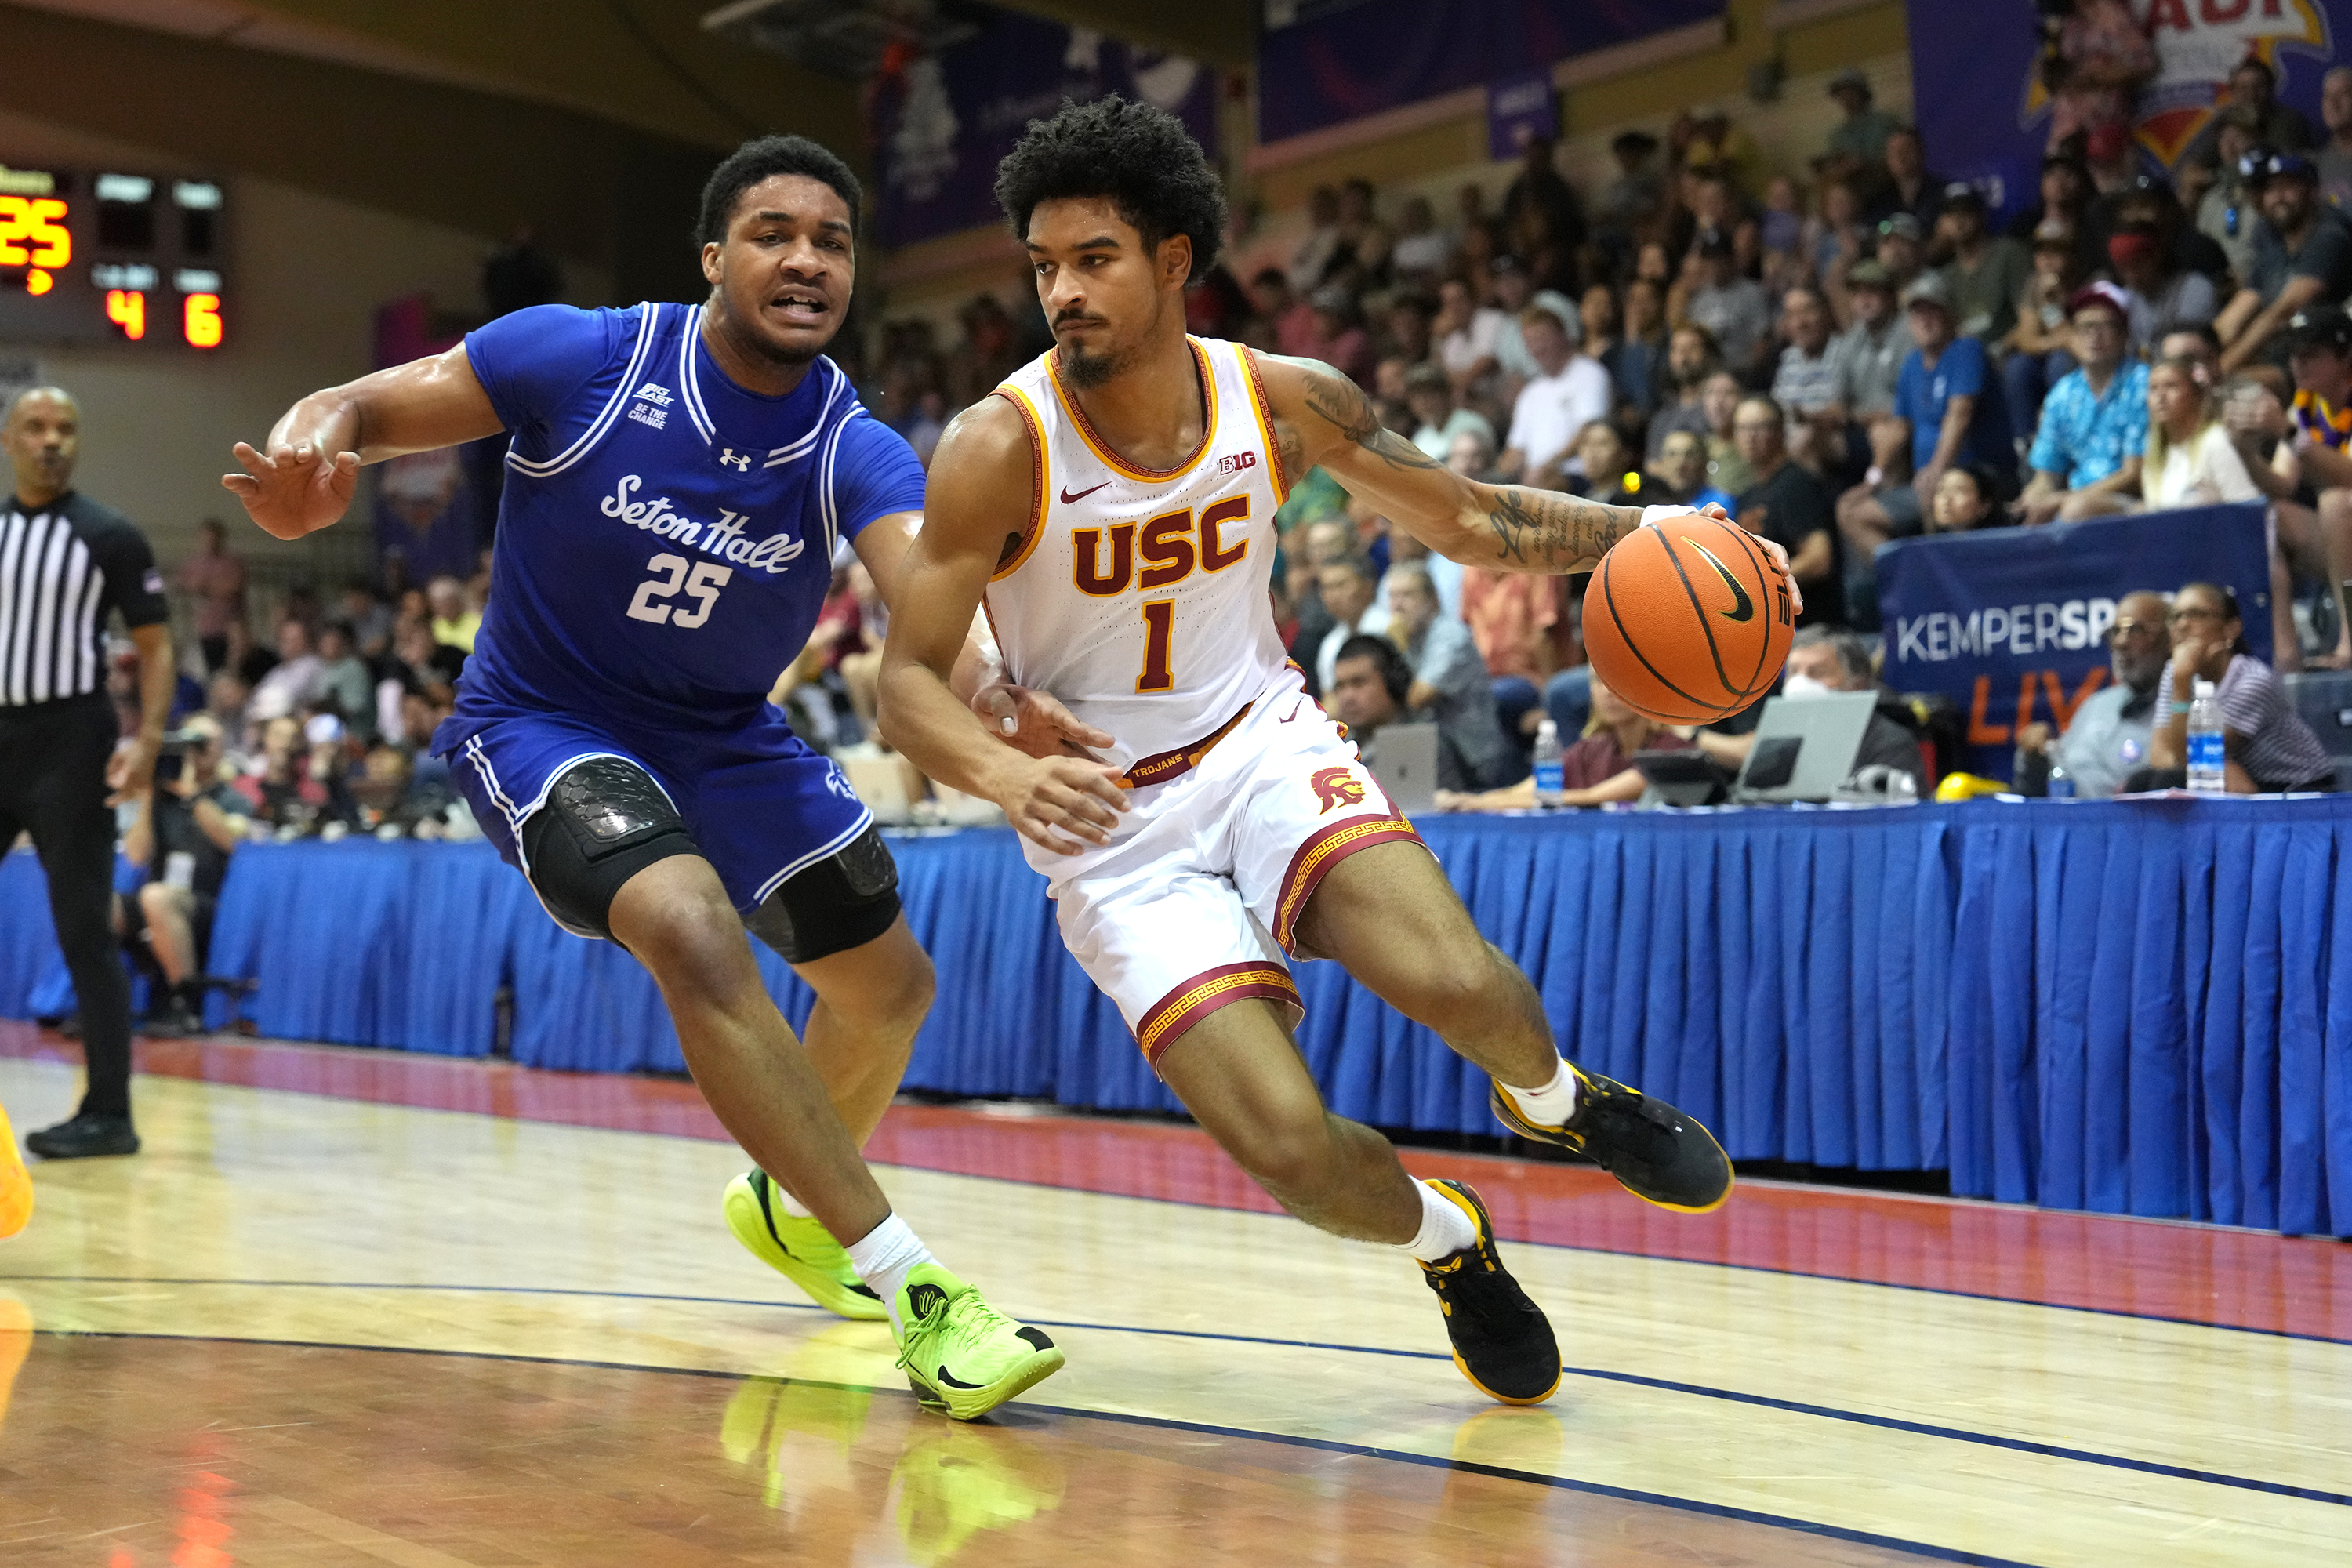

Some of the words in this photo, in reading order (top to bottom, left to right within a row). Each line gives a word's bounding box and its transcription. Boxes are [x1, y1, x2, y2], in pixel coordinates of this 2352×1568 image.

[106, 289, 145, 340] 4
[184, 293, 223, 348] 6
[634, 402, 649, 414] BE
[649, 408, 668, 421] THE
[636, 389, 675, 405] EAST
[642, 382, 670, 396] BIG
[628, 409, 666, 430] CHANGE
[601, 474, 699, 546] Seton
[699, 507, 804, 574] Hall
[1071, 492, 1250, 597] USC
[1490, 490, 1537, 564] Life
[1594, 508, 1619, 554] God
[626, 552, 734, 629] 25
[1135, 598, 1175, 694] 1
[1896, 597, 2118, 663] KEMPERSP
[1967, 666, 2109, 745] LIV
[1132, 753, 1183, 777] TROJANS
